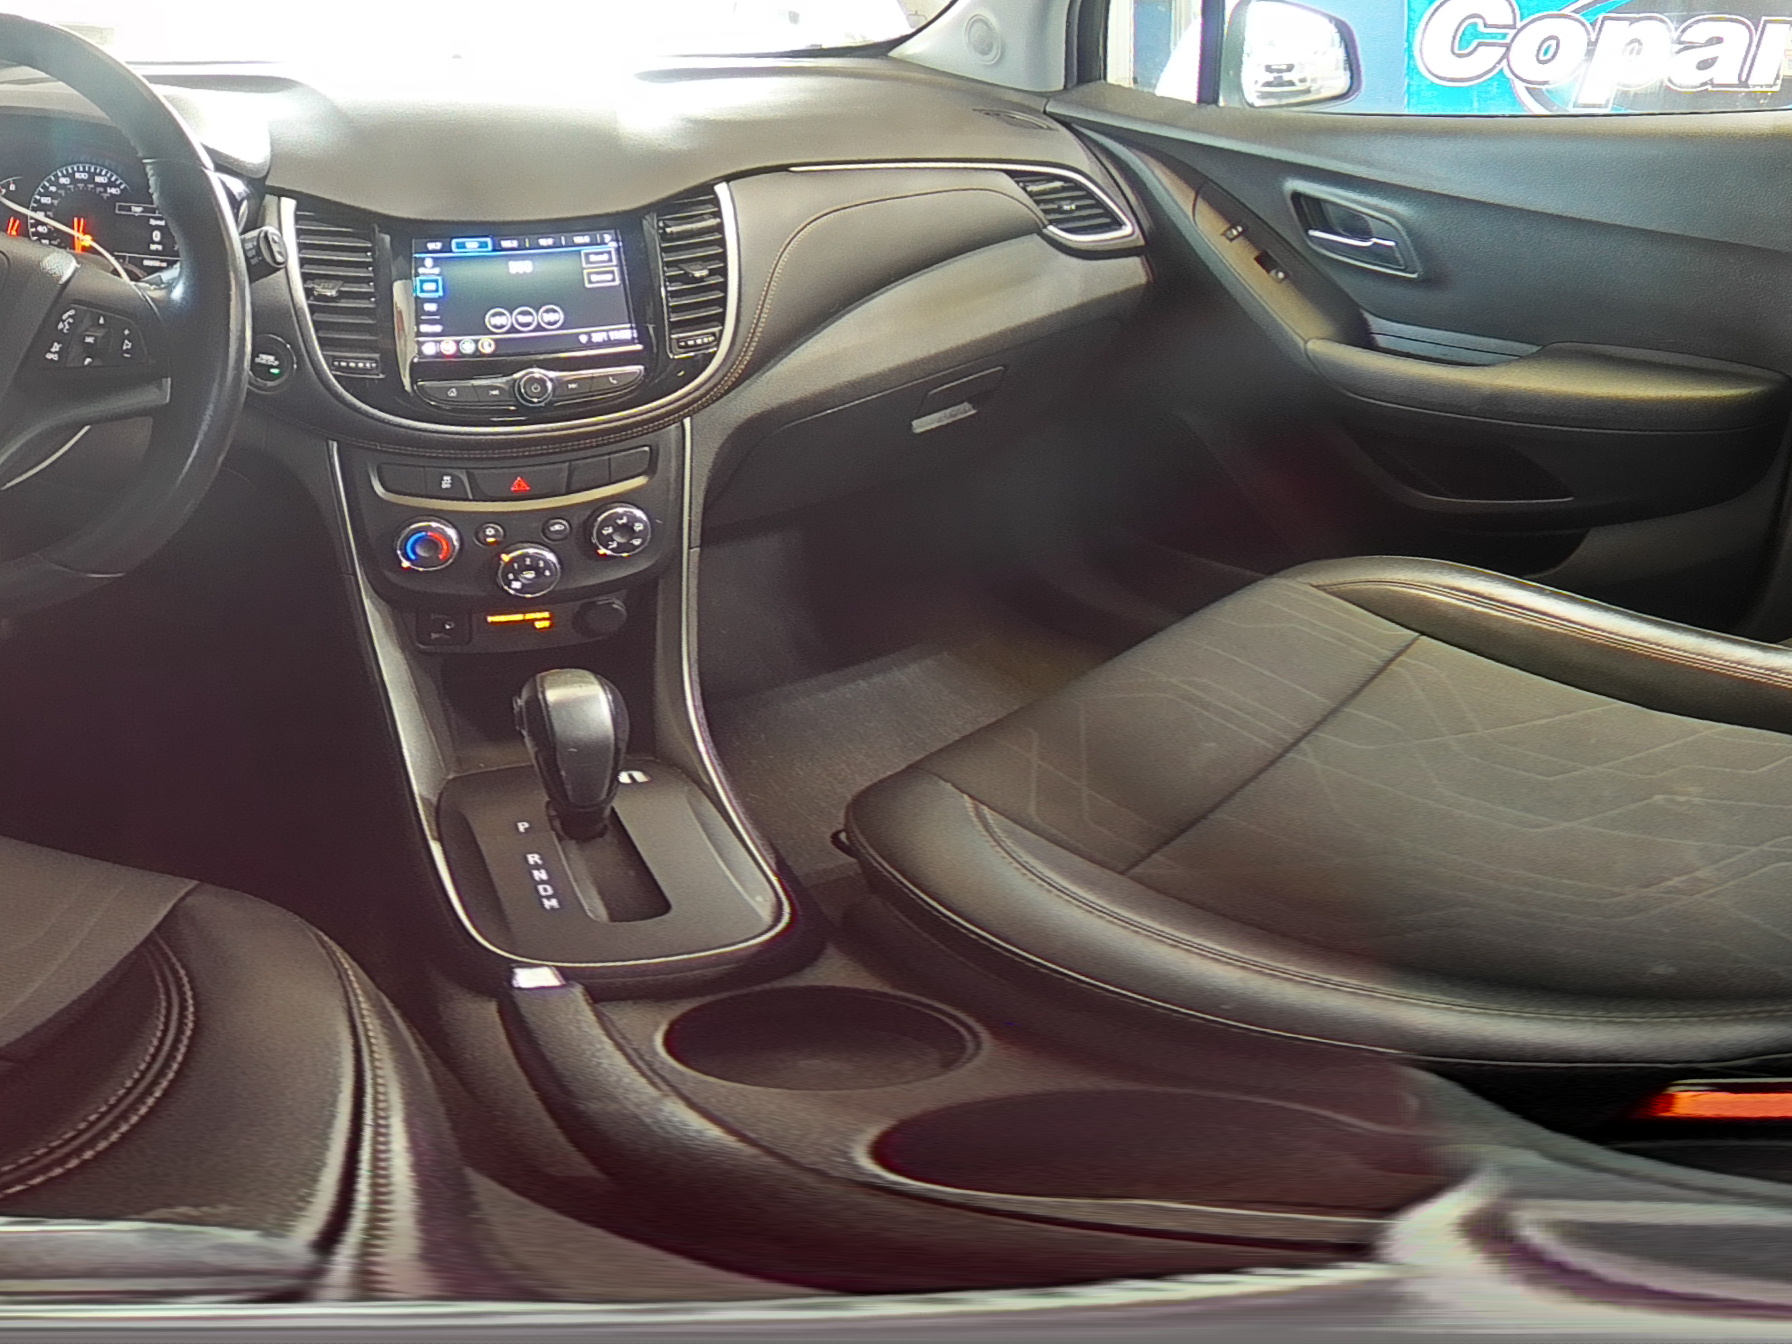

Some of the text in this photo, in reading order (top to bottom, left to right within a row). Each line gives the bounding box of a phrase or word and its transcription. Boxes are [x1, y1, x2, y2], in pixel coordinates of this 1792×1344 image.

[152, 230, 161, 242] 0
[516, 821, 530, 833] P
[526, 853, 543, 865] R
[531, 868, 549, 882] N
[536, 884, 554, 896] D
